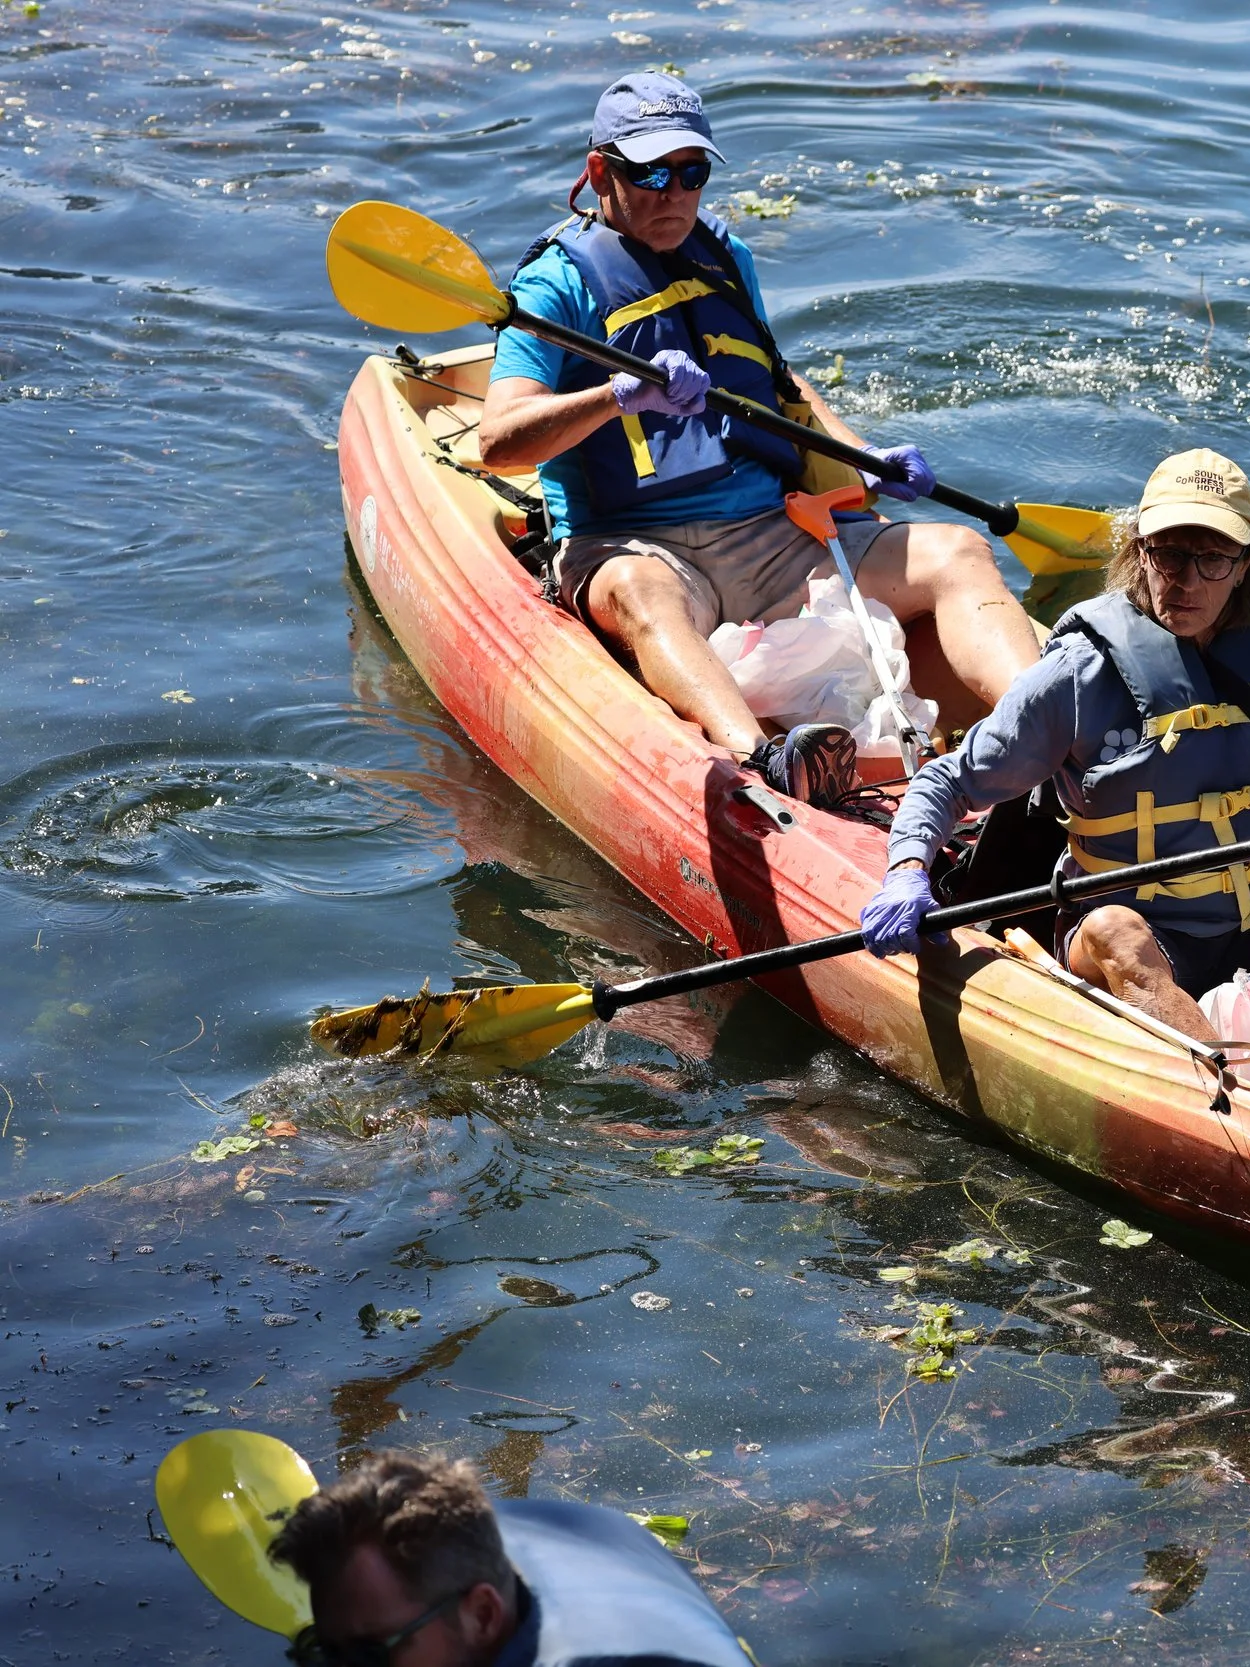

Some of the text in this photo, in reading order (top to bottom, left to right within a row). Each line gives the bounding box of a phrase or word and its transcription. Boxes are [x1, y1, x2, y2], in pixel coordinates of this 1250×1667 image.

[1175, 475, 1225, 489] CONGRESS
[1194, 469, 1224, 482] SOUTH
[1196, 484, 1226, 496] HOTEL
